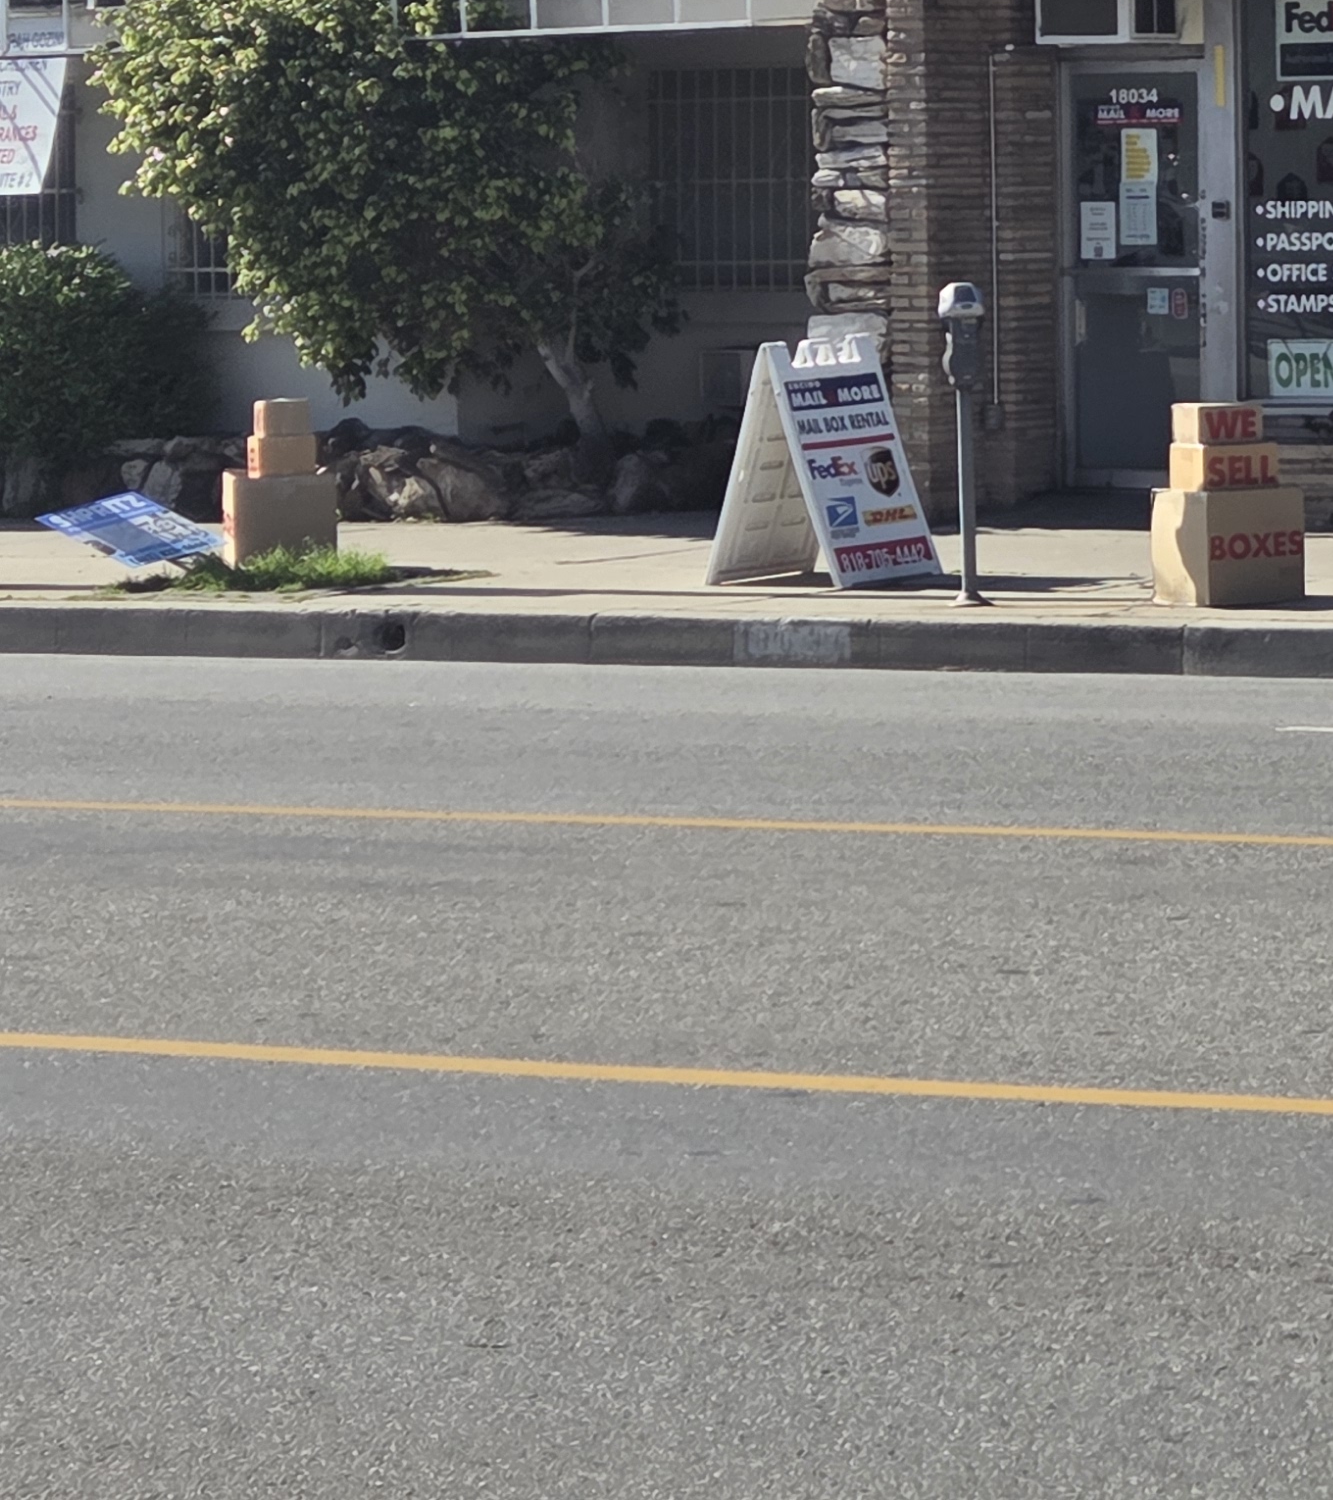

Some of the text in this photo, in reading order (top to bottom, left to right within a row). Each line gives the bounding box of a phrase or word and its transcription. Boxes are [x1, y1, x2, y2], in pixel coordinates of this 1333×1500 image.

[1109, 88, 1159, 104] 18034
[1266, 263, 1327, 282] OFFICE
[837, 383, 882, 403] MORE
[797, 410, 890, 436] MAIL BOX RENTAL
[1204, 408, 1257, 440] WE
[807, 455, 897, 490] FedEx ups
[1207, 455, 1279, 488] SELL
[871, 509, 912, 523] DHL
[1210, 530, 1301, 562] BOXES
